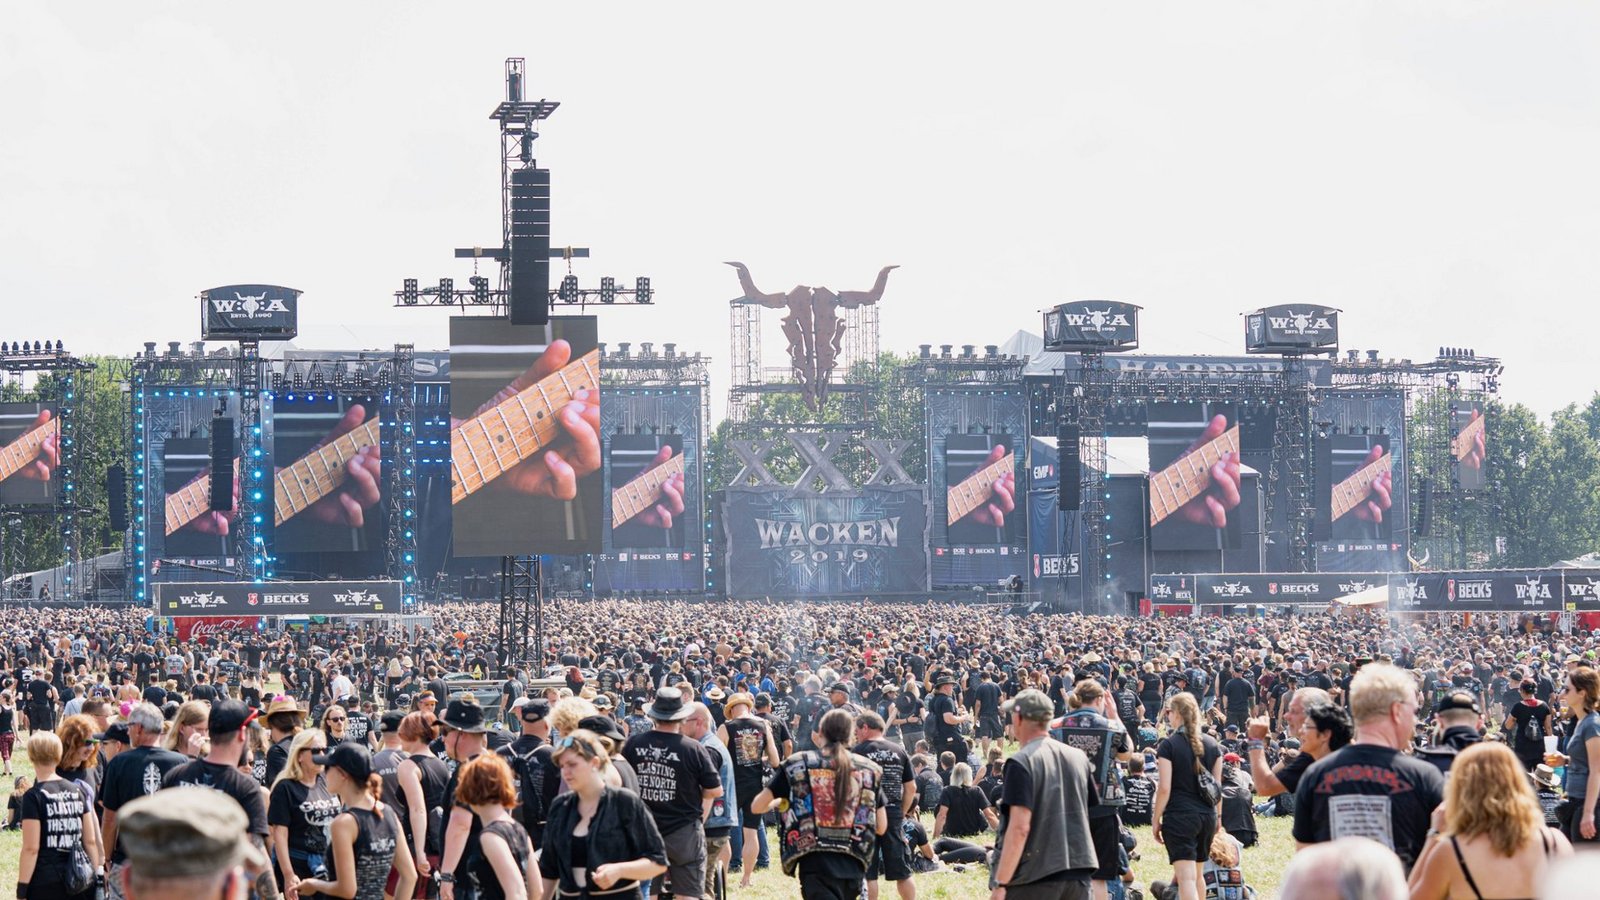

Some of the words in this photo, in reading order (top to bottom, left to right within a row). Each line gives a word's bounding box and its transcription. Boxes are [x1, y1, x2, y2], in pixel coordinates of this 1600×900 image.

[755, 517, 900, 549] WACKEN
[790, 549, 868, 564] 2019
[1281, 583, 1319, 593] BECK'S
[1459, 581, 1492, 599] BECK'S
[637, 762, 675, 779] BLASTING
[649, 776, 677, 790] NORTH
